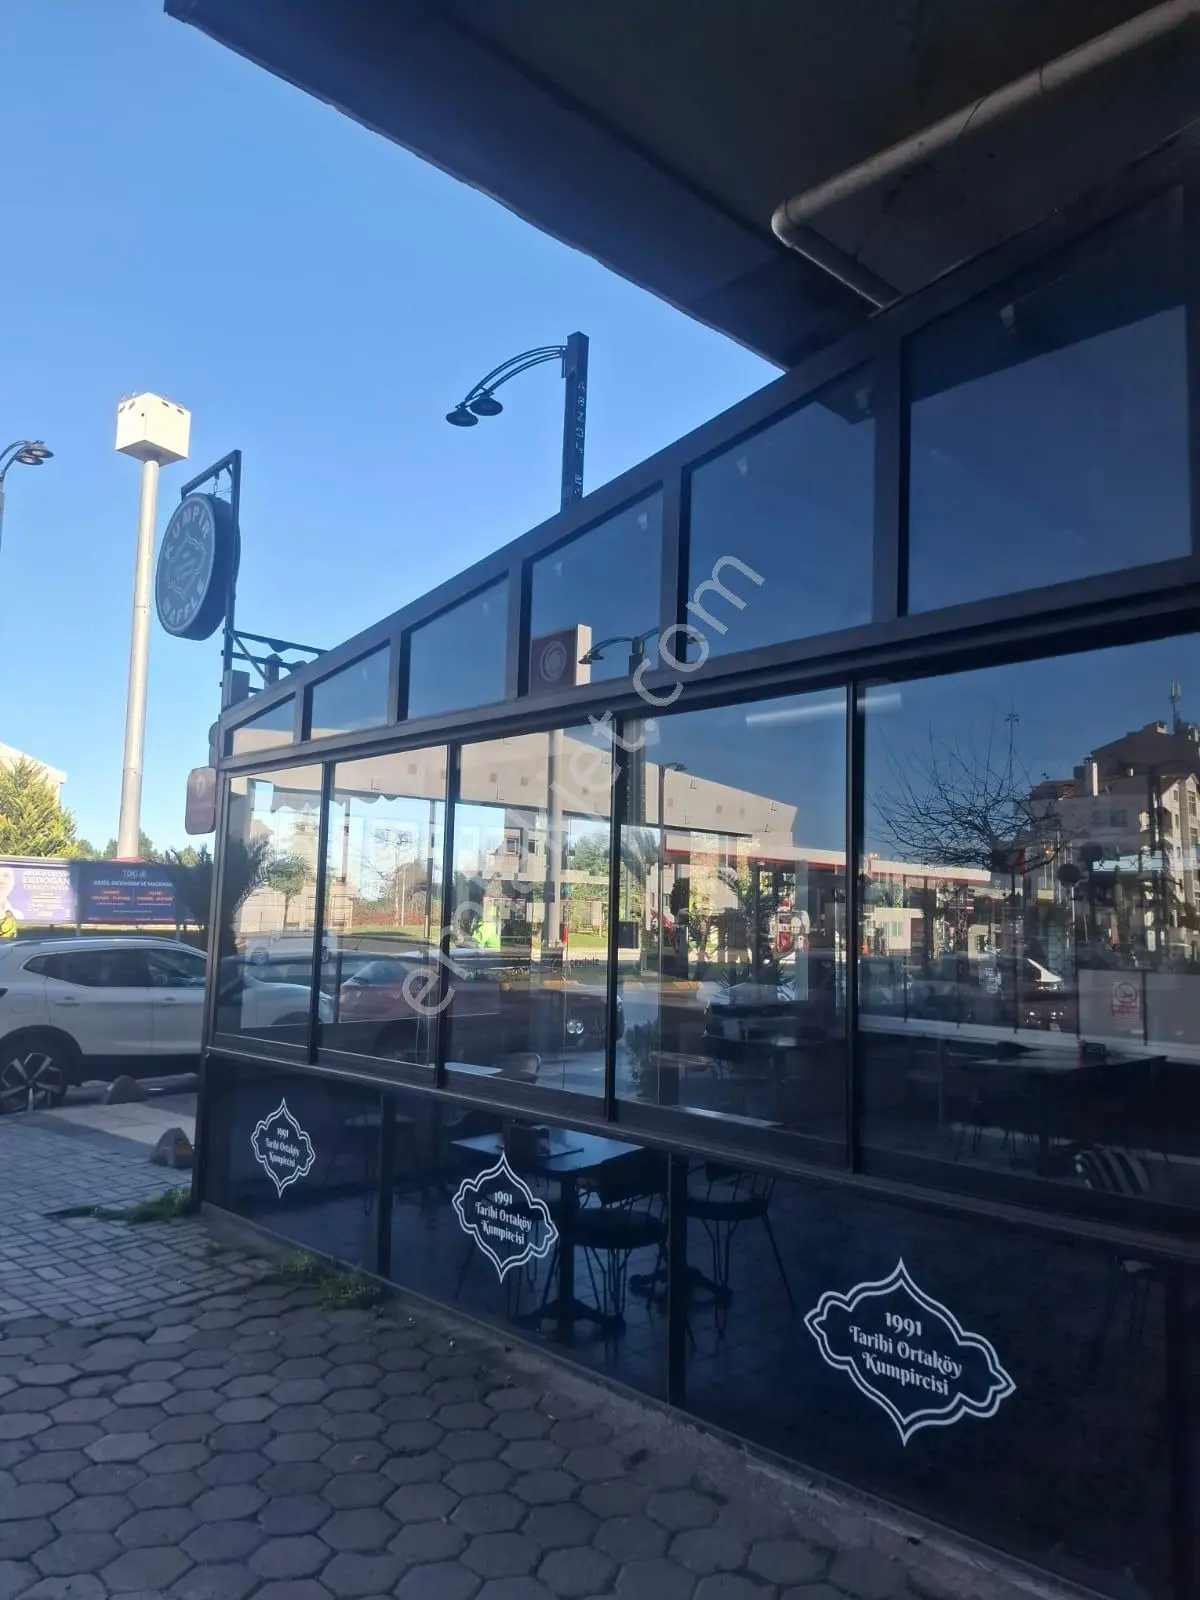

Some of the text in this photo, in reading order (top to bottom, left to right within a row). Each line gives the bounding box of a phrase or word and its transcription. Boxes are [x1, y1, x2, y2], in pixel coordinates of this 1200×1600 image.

[494, 1190, 513, 1206] 1991
[475, 1202, 532, 1232] Tarihi Ortaköy
[481, 1220, 525, 1245] Kumpircisi
[885, 1312, 922, 1337] 1991
[849, 1325, 962, 1379] Tarihi Ortaköy
[862, 1352, 949, 1396] Kumpircisi
